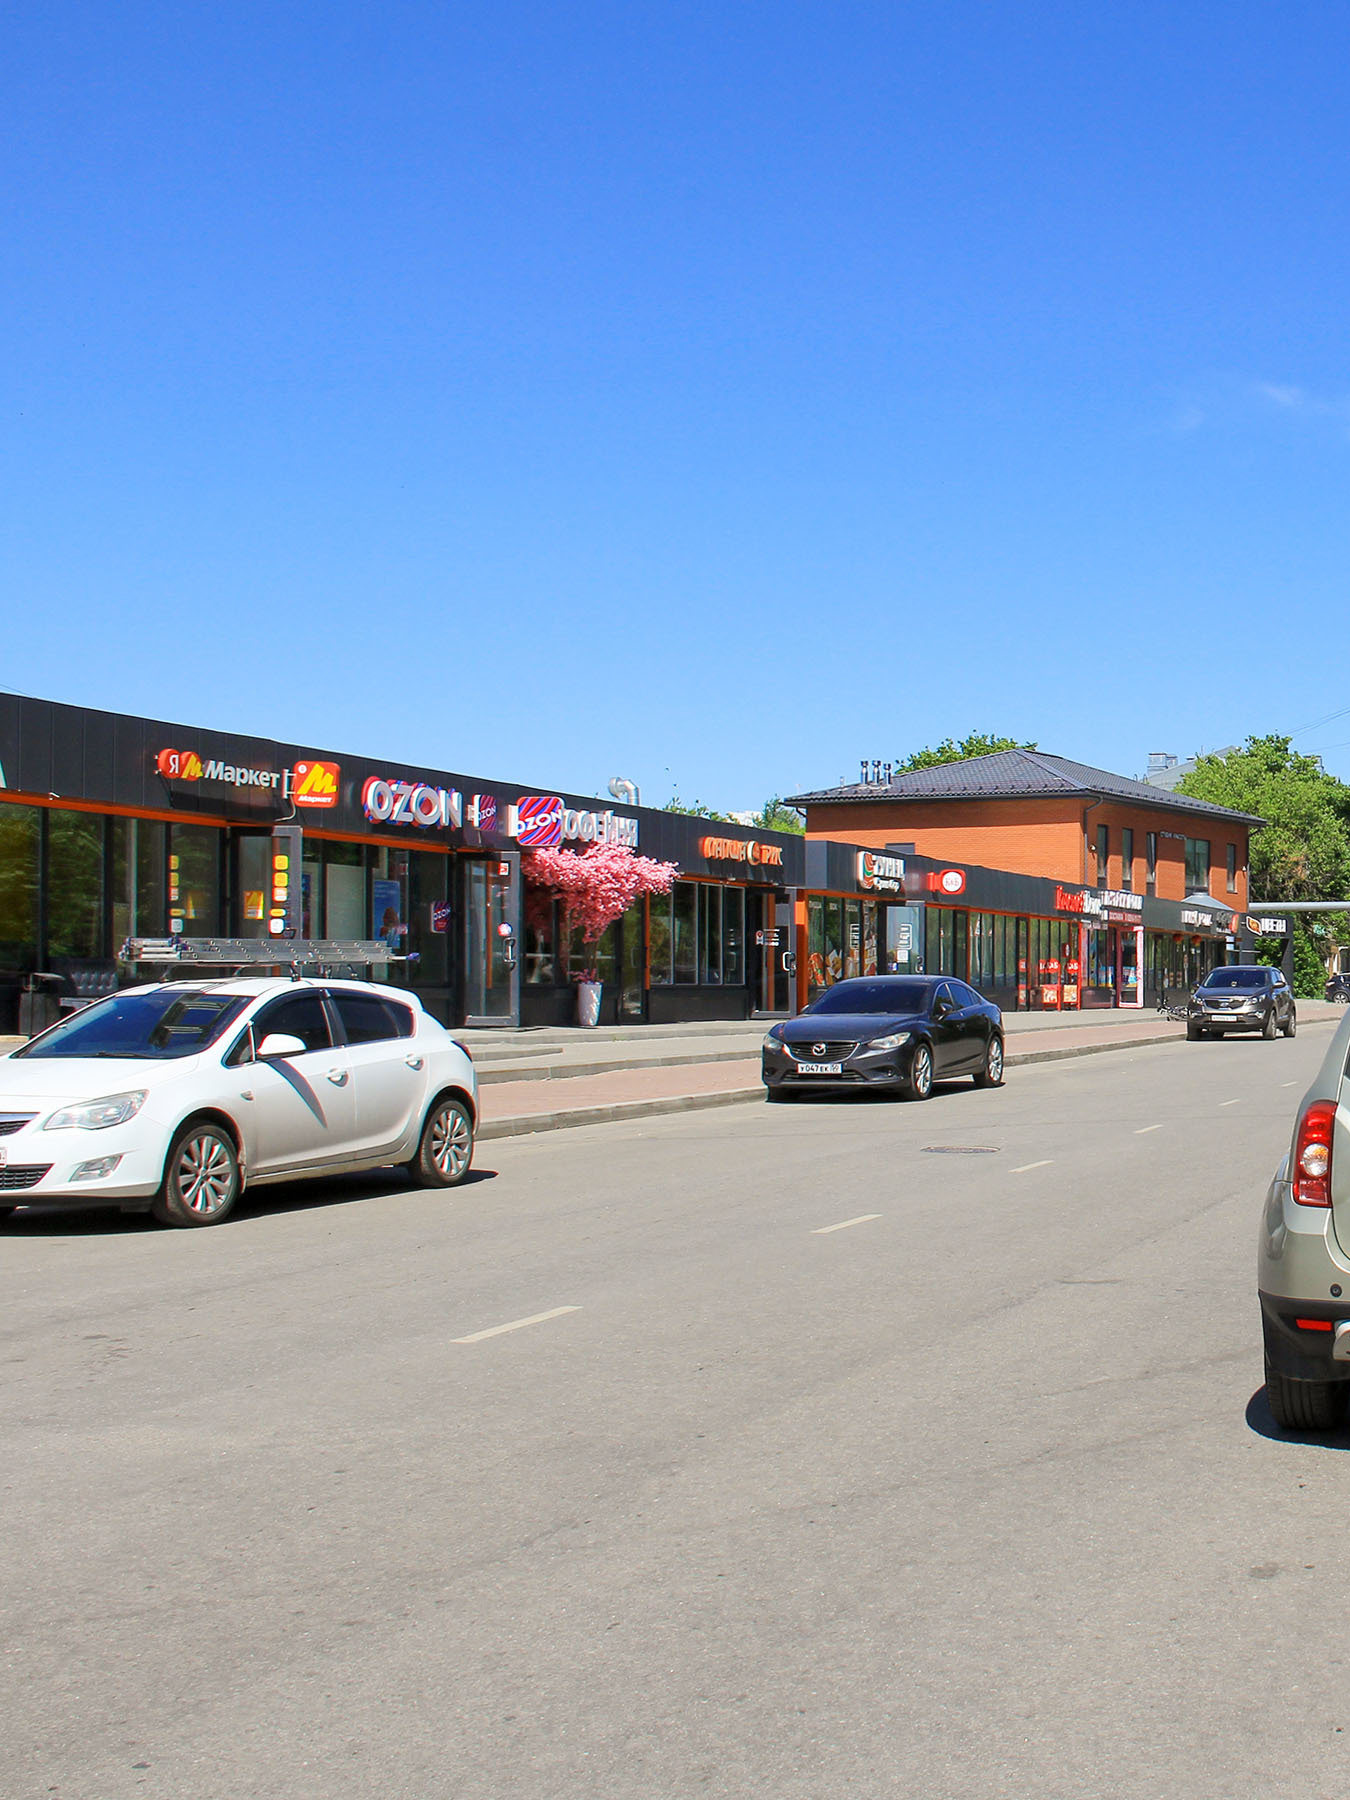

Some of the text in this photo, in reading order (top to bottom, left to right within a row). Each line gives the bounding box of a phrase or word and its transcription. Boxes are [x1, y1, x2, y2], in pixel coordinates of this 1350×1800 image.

[169, 754, 179, 774] Я
[204, 759, 281, 788] Маркет
[366, 780, 463, 828] OZON
[516, 808, 562, 834] OZON
[560, 808, 639, 847] ОФЕЙНЯ
